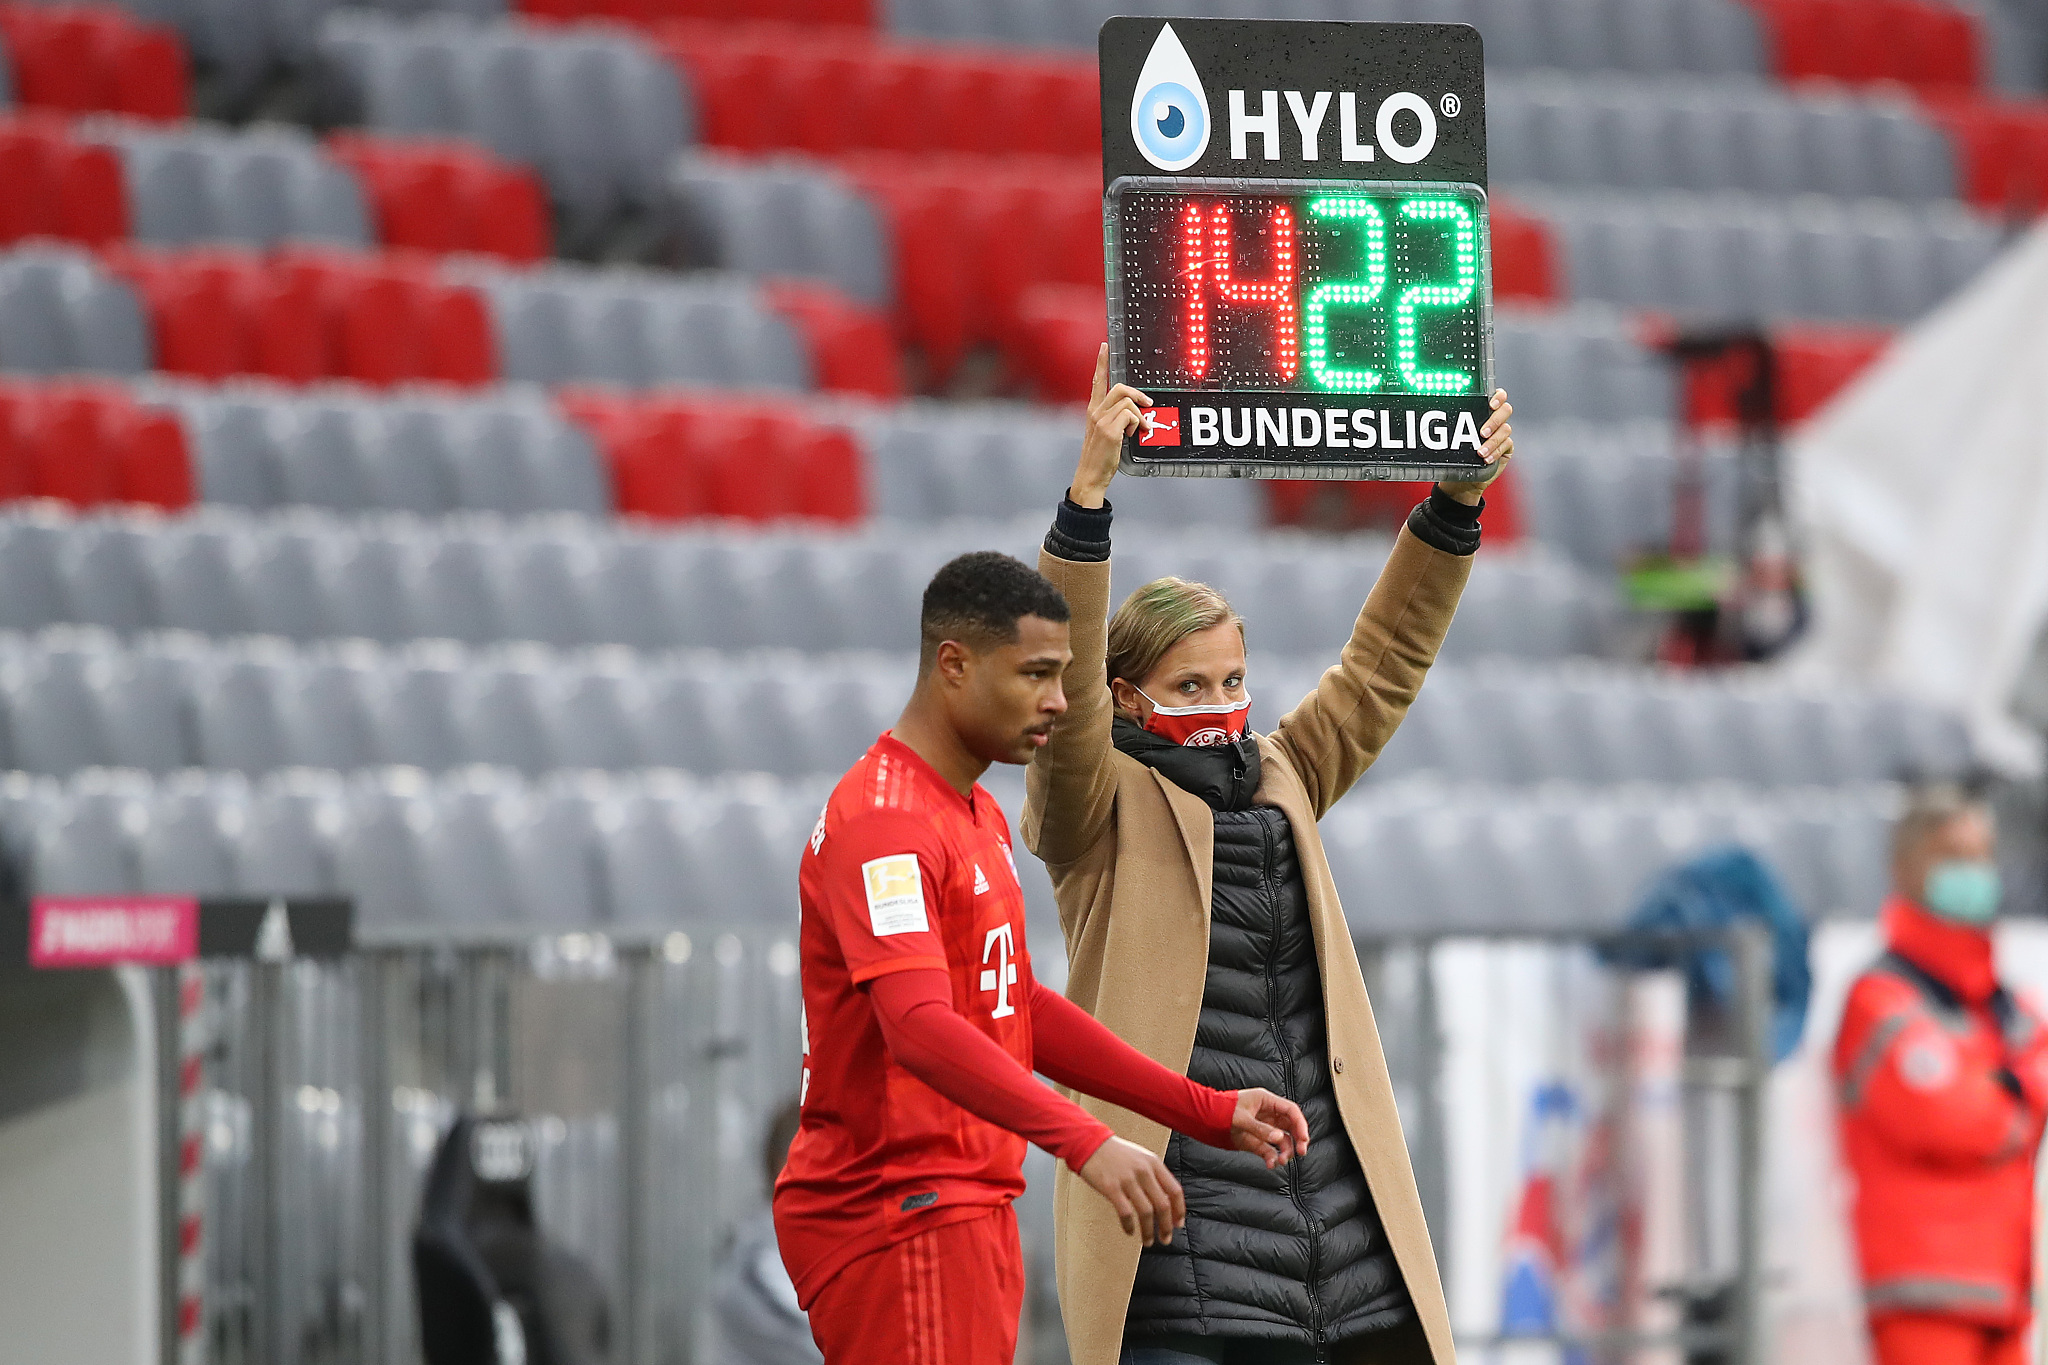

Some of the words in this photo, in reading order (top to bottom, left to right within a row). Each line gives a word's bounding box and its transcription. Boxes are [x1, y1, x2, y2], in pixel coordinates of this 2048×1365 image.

[1186, 203, 1297, 380] 14
[1308, 197, 1474, 392] 22
[1191, 406, 1483, 451] BUNDESLIGA
